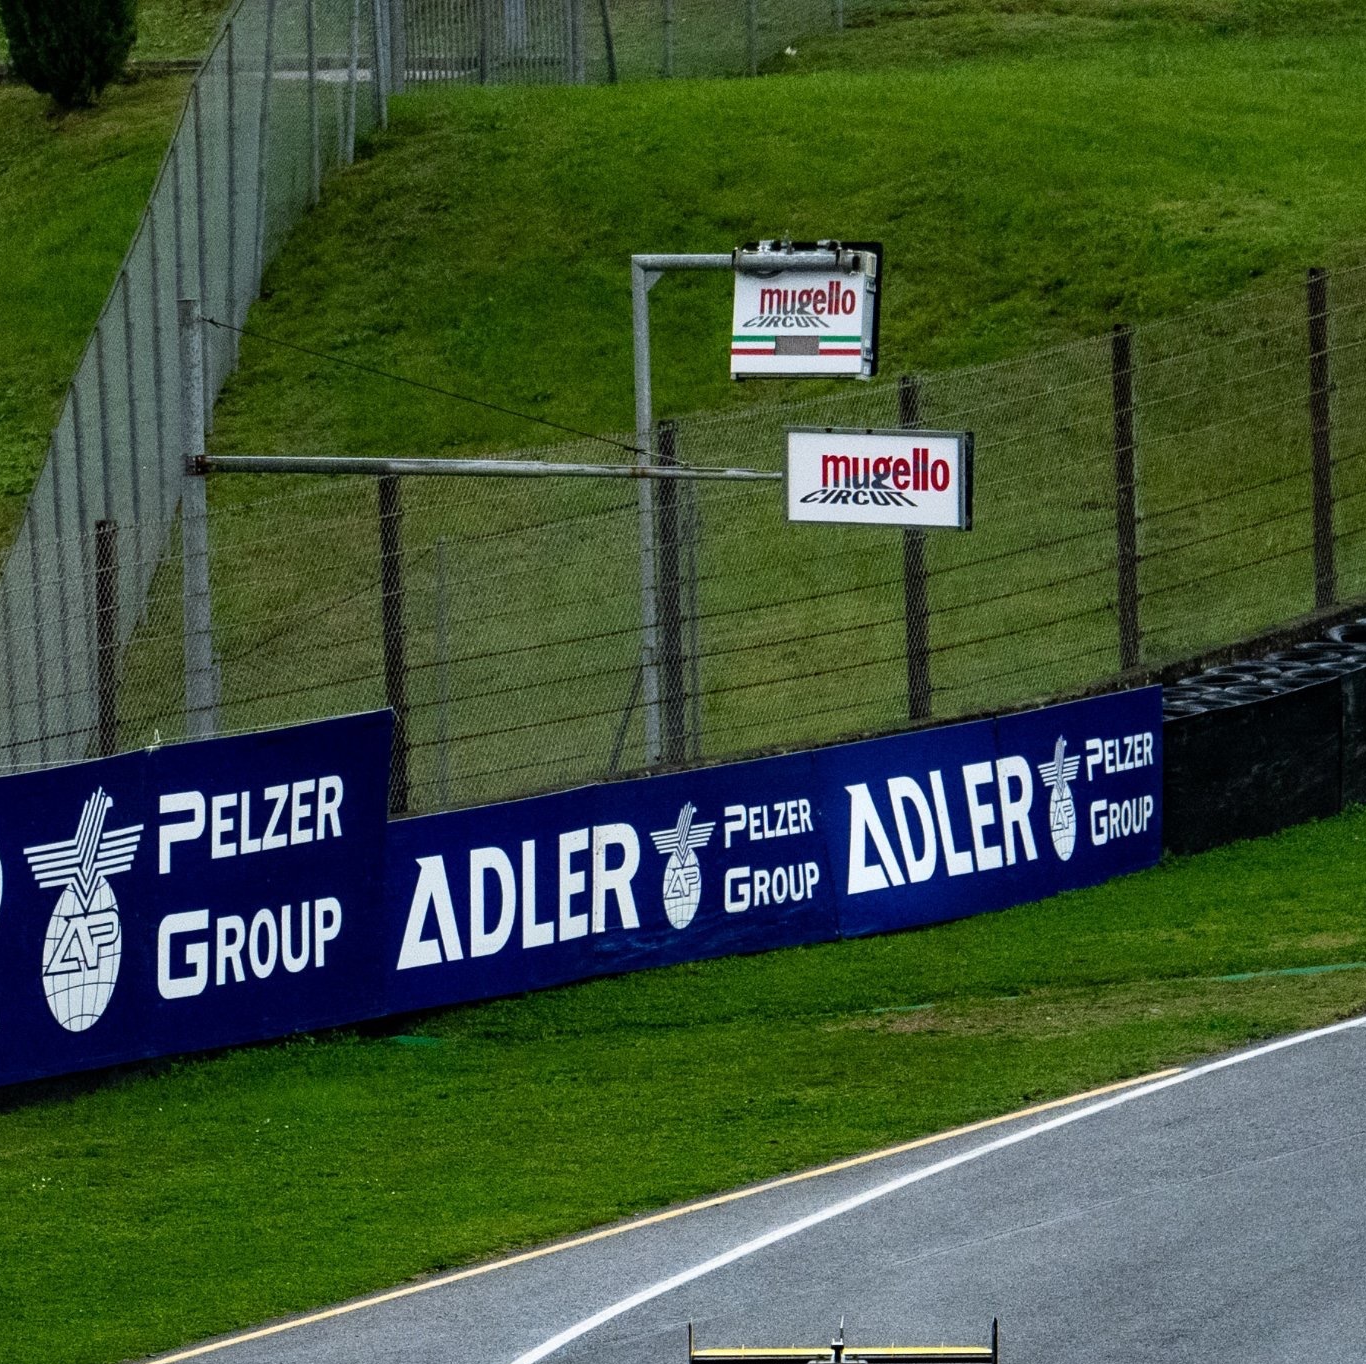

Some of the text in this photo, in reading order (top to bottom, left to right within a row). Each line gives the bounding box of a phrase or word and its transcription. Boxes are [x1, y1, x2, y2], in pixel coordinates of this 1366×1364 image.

[742, 316, 830, 329] CIRCUIT
[759, 280, 856, 316] mugello
[822, 447, 950, 492] mugello
[799, 489, 918, 508] CIRCUIT
[1086, 732, 1153, 783] PELZER
[159, 774, 344, 875] PELZER
[724, 798, 814, 849] PELZER
[844, 756, 1037, 896] ADLER
[1089, 794, 1154, 847] GROUP
[396, 822, 641, 971] ADLER
[724, 862, 821, 914] GROUP
[156, 896, 343, 1000] GROUP
